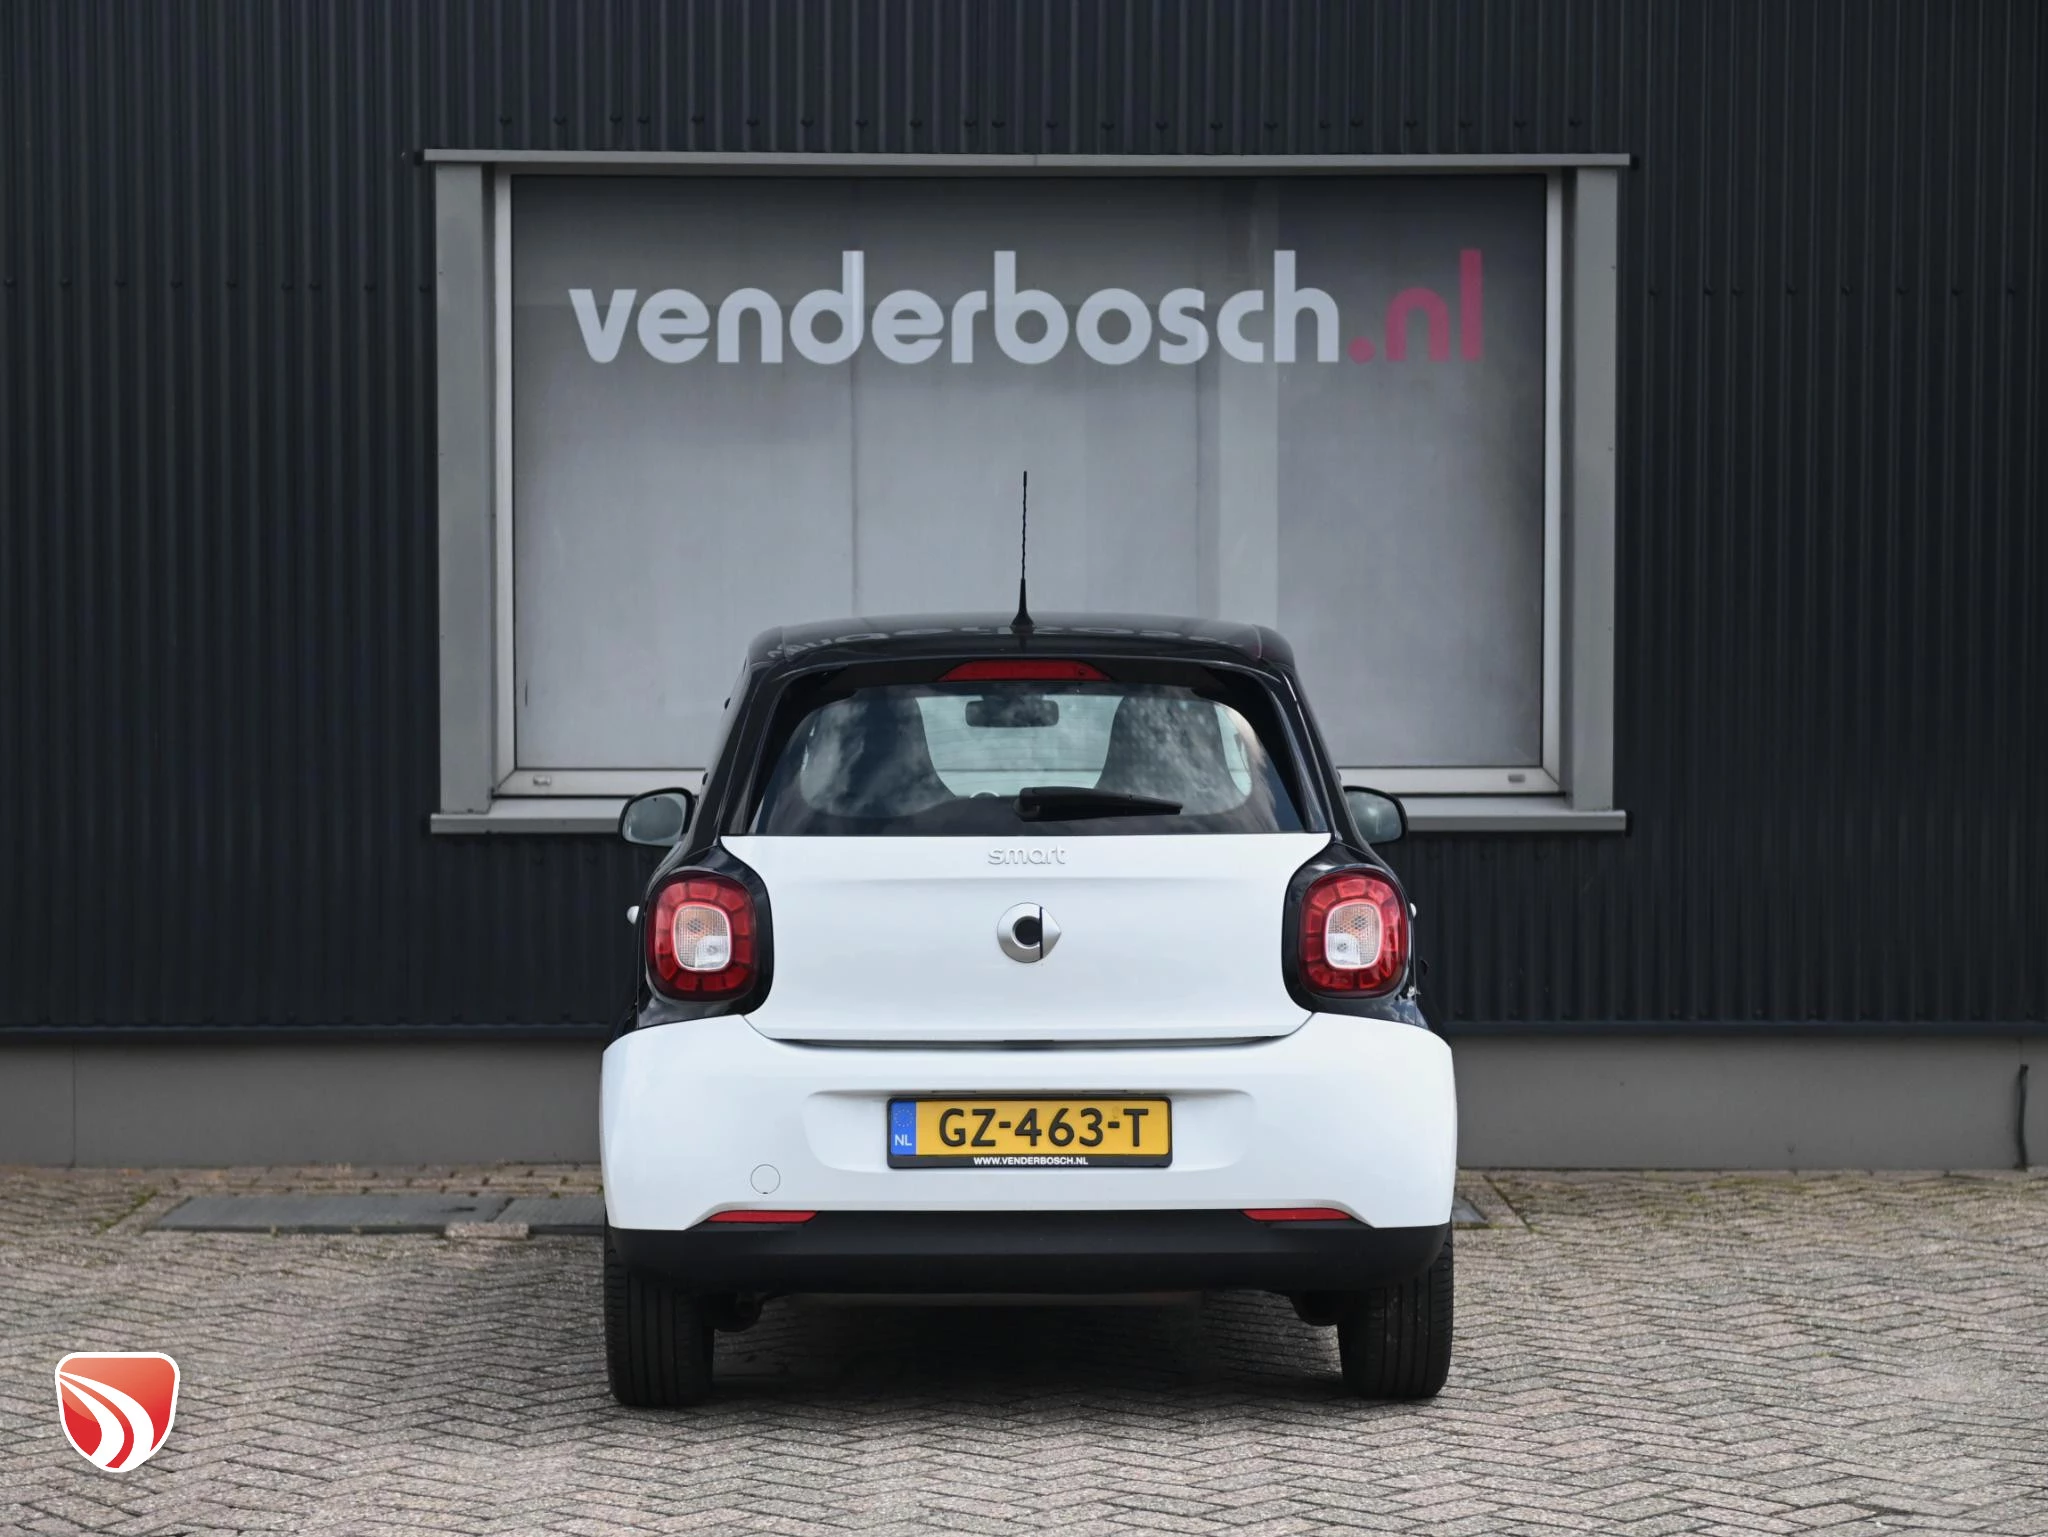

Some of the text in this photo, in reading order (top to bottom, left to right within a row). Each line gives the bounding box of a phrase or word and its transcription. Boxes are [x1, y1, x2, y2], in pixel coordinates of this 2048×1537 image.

[568, 249, 1483, 365] venderbosch.nl
[987, 845, 1066, 866] smart
[938, 1107, 1149, 1147] GZ-463-T
[894, 1134, 913, 1147] NL
[973, 1156, 1089, 1166] WWW.VENDERBOSCH.NL
